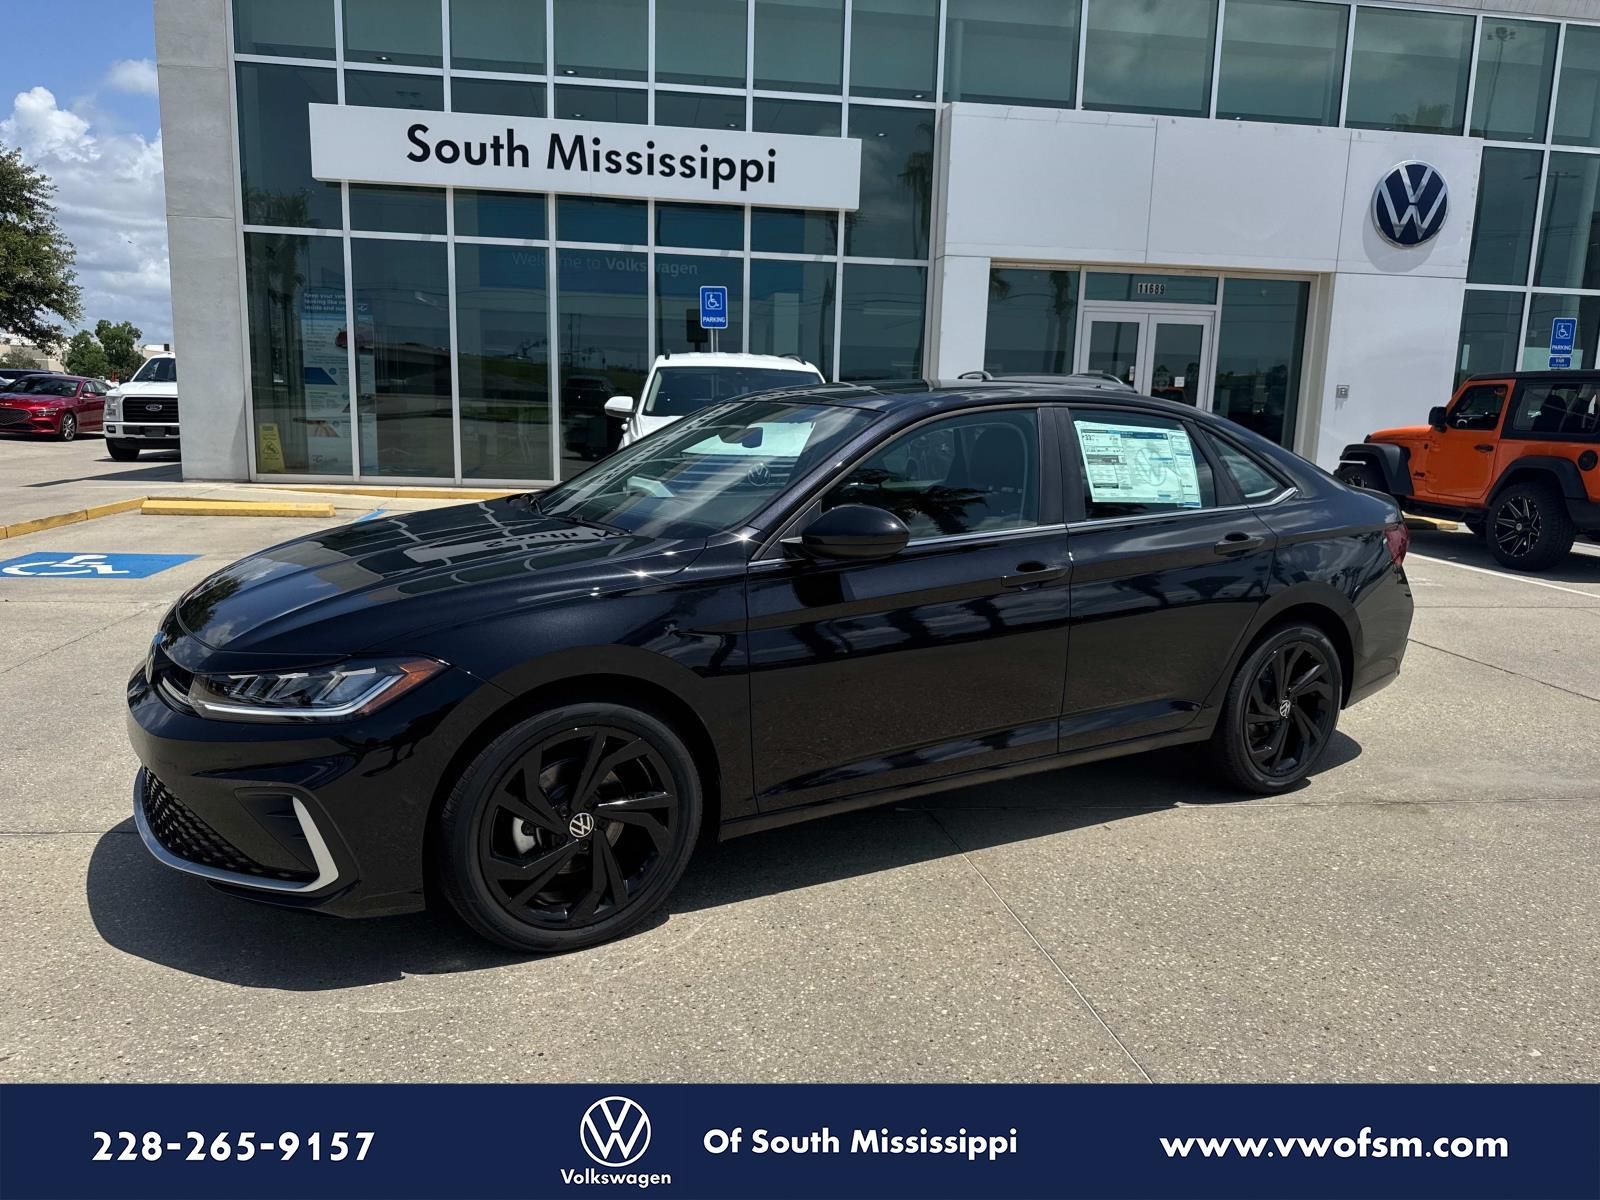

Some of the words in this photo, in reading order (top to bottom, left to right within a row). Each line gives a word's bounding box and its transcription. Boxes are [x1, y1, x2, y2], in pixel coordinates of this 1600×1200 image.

[406, 123, 530, 168] South
[546, 132, 777, 192] Mississippi
[511, 252, 582, 269] Welcme
[585, 256, 601, 270] to
[1138, 282, 1166, 296] 11689
